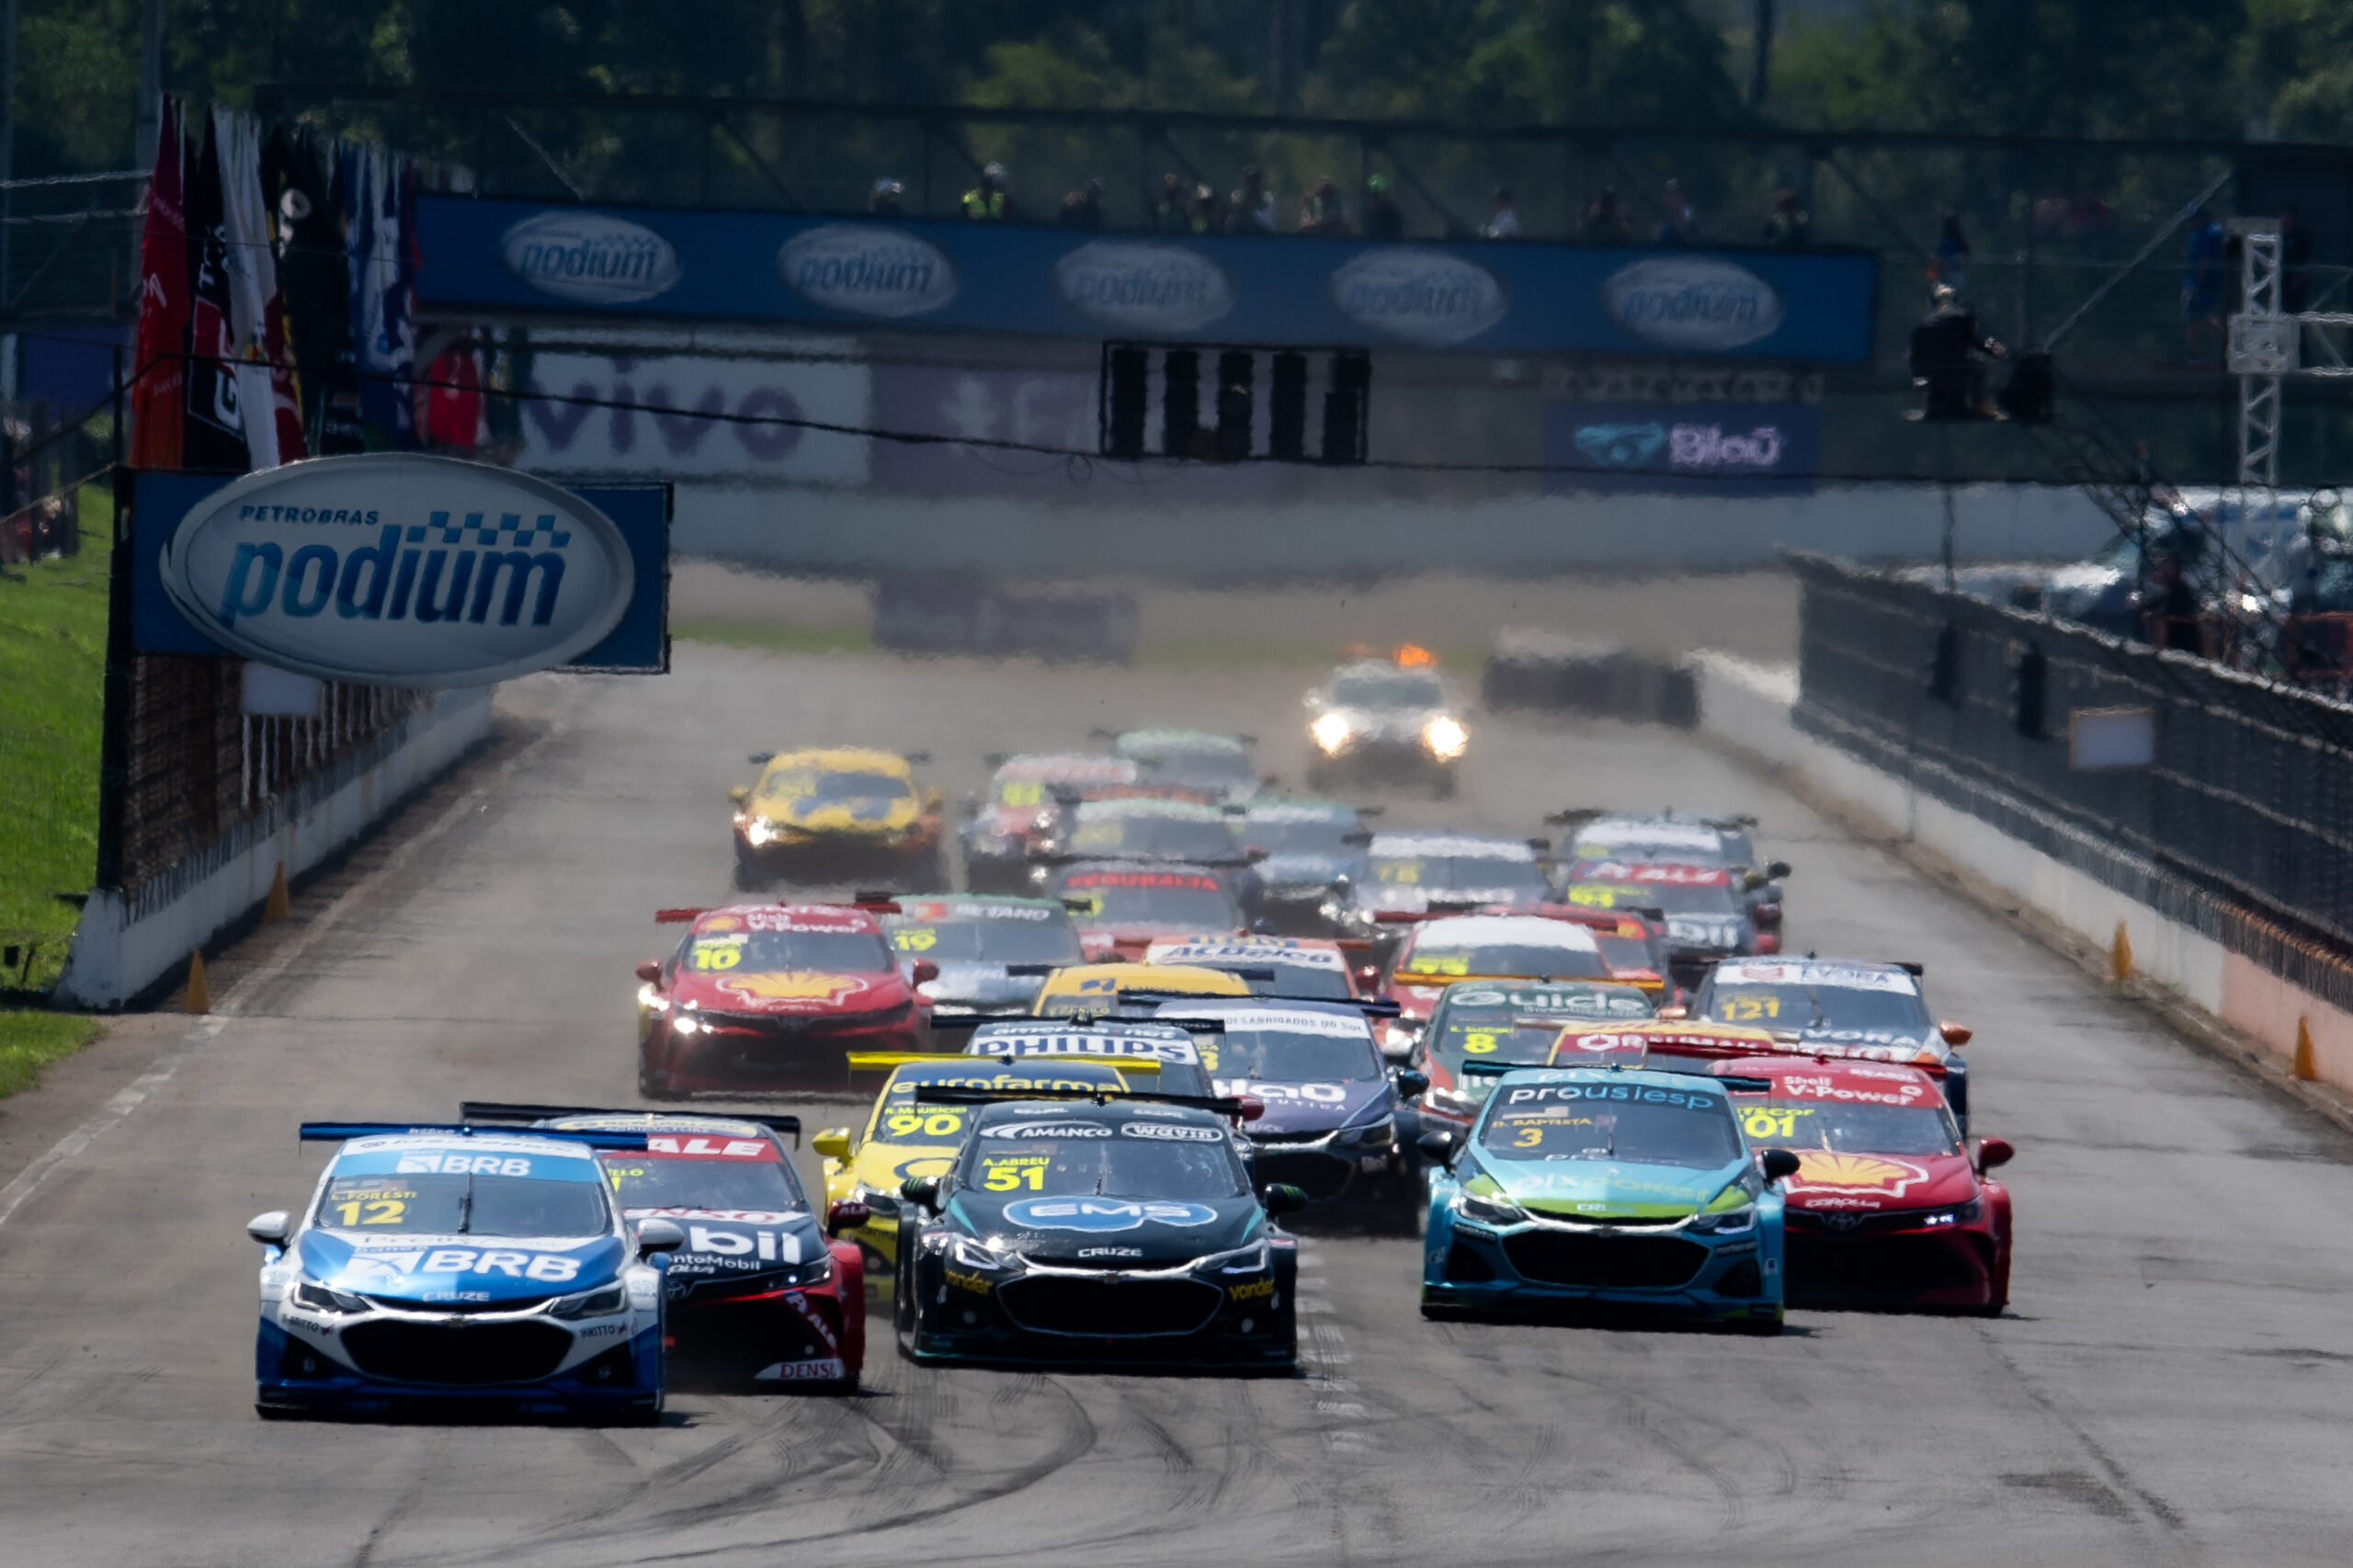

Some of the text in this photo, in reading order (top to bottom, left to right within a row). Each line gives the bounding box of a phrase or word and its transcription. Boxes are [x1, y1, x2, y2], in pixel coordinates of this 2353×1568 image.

[526, 351, 806, 461] vivo
[239, 506, 379, 525] PETROBRAS
[219, 525, 564, 629] podium
[954, 903, 1051, 920] BETANO
[895, 934, 937, 951] 19
[693, 948, 743, 971] 10
[1722, 995, 1780, 1021] 121
[978, 1037, 1187, 1061] PHILIPS
[1463, 1033, 1499, 1053] 8
[891, 1074, 1123, 1094] eurofarma
[1783, 1075, 1832, 1086] Shell
[1786, 1085, 1915, 1106] V-Power
[887, 1114, 961, 1137] 90
[1020, 1127, 1113, 1139] AMANCO
[1738, 1114, 1797, 1139] 01
[646, 1138, 767, 1157] ALE
[1512, 1128, 1544, 1147] 3
[440, 1156, 531, 1177] BRB
[982, 1156, 1051, 1167] A.ABREU
[983, 1166, 1045, 1192] 51
[335, 1200, 406, 1227] 12
[838, 1204, 868, 1215] ALE
[1029, 1203, 1192, 1219] EMS
[689, 1226, 801, 1265] bil
[1077, 1246, 1143, 1258] CRUZE
[421, 1249, 582, 1282] BRB
[945, 1268, 994, 1296] vonder
[421, 1290, 491, 1303] CRUZE
